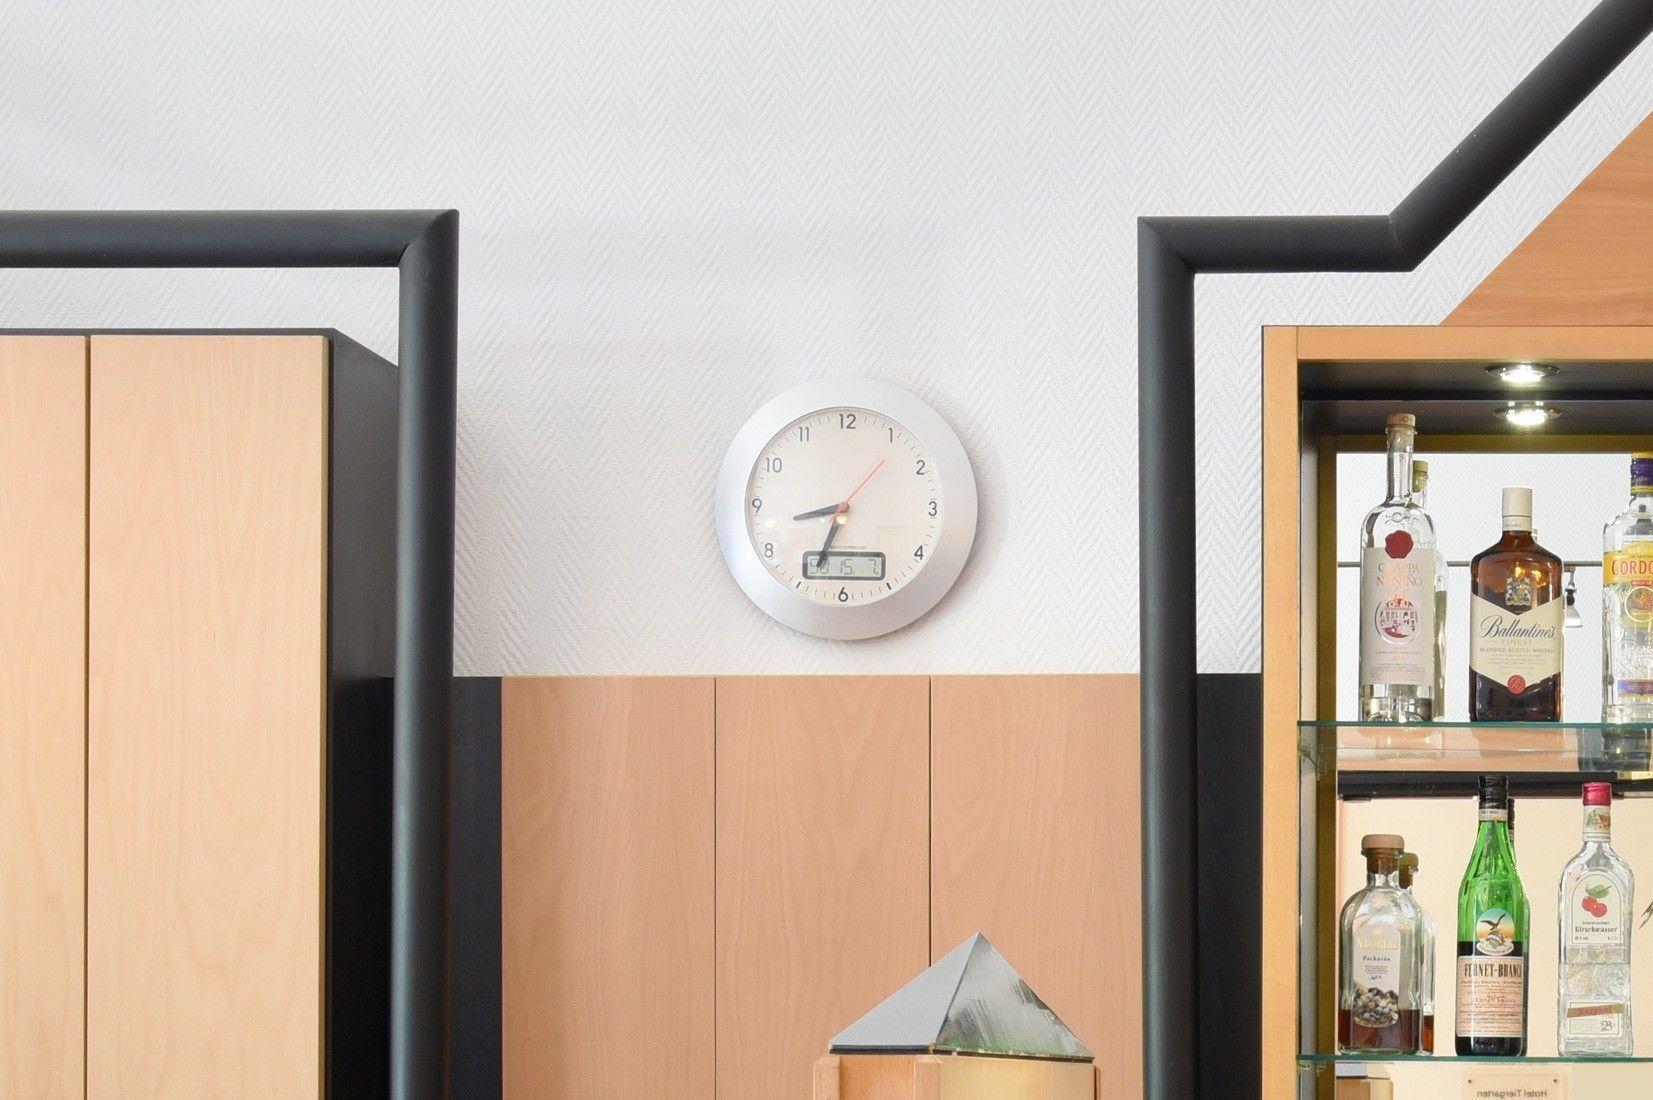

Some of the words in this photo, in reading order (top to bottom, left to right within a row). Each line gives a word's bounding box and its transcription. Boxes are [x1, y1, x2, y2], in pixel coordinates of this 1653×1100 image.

[839, 414, 857, 430] 12
[799, 426, 810, 442] 11
[888, 428, 894, 443] 1
[766, 457, 783, 473] 10
[915, 460, 926, 476] 2
[751, 498, 763, 514] 9
[928, 501, 938, 517] 3
[764, 543, 774, 558] 8
[914, 545, 925, 560] 4
[838, 586, 849, 602] 6
[1479, 614, 1558, 640] Ballantine's
